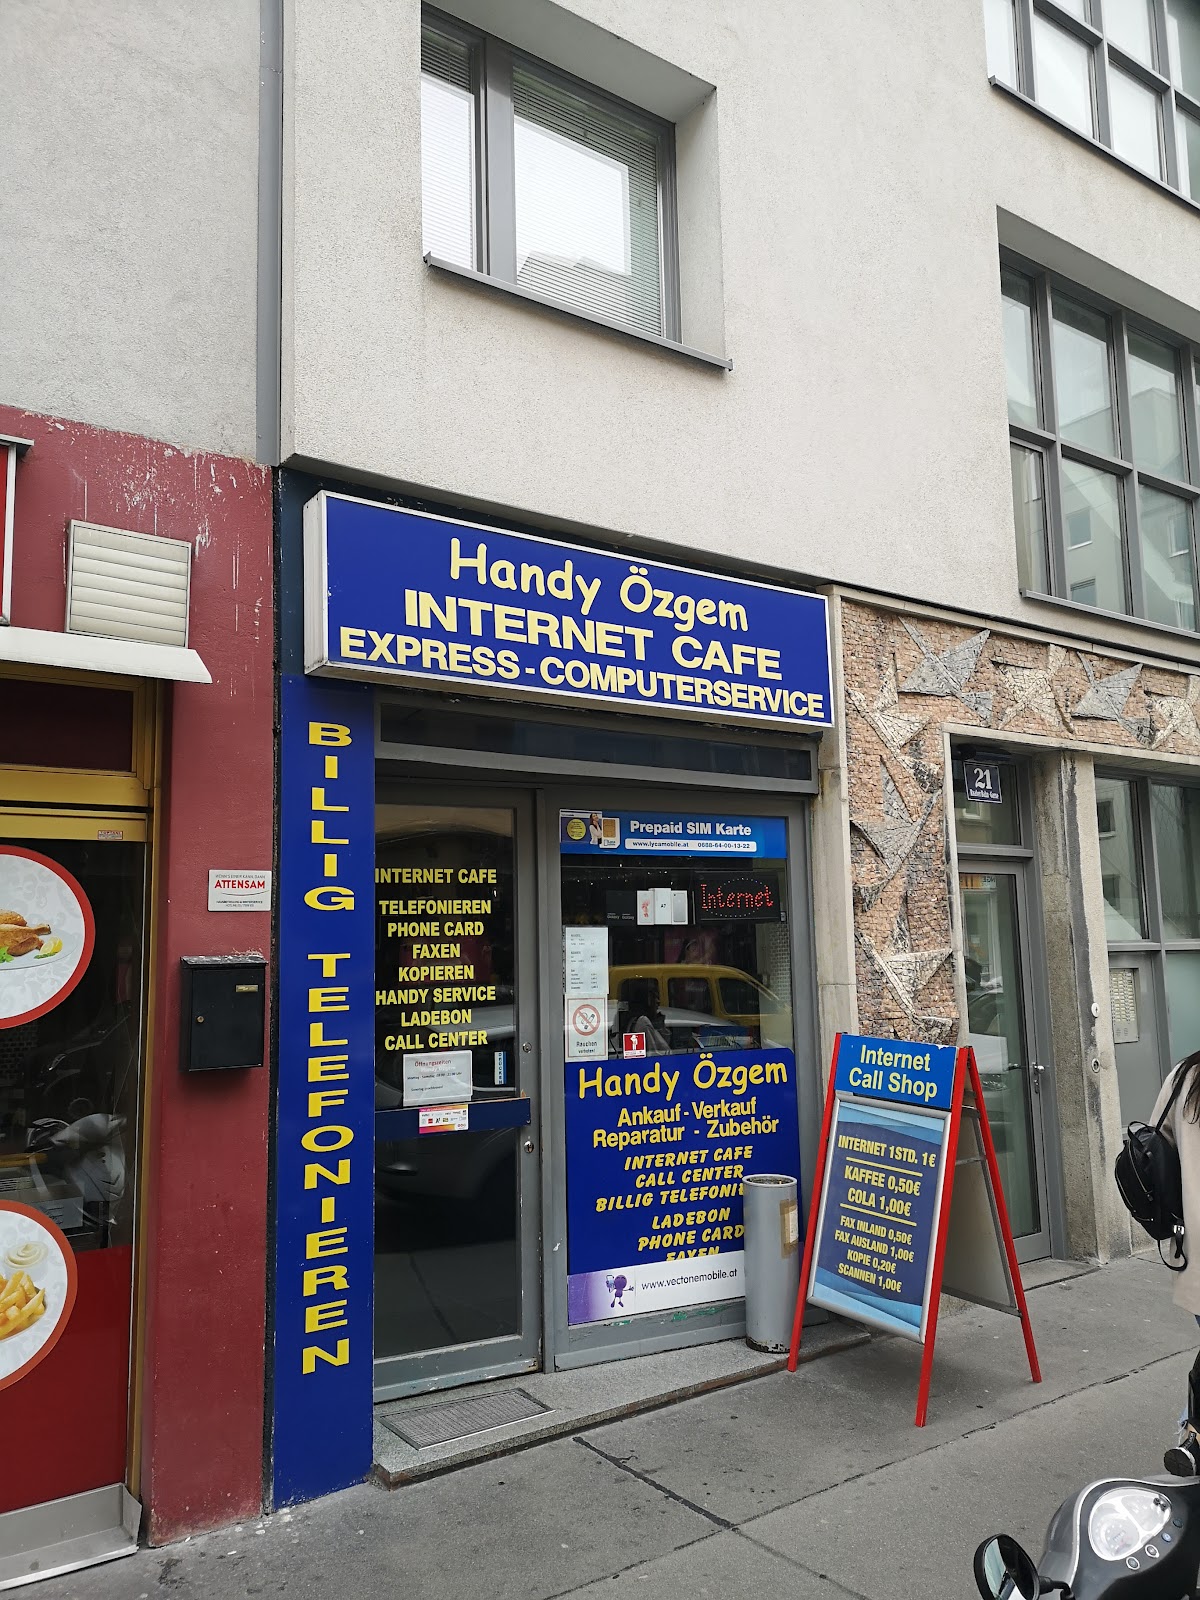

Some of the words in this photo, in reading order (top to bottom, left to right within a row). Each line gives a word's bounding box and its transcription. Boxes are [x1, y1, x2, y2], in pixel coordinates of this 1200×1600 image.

[450, 538, 601, 615] Handy
[620, 566, 749, 632] Özgem
[404, 590, 654, 662] INTERNET
[672, 637, 782, 680] CAFE
[340, 627, 519, 680] EXPRESS
[540, 657, 824, 718] COMPUTERSERVICE
[974, 768, 992, 789] 21
[303, 721, 355, 911] BILLIG
[630, 820, 682, 835] Prepaid
[686, 821, 712, 835] SIM
[716, 822, 751, 836] Karte
[214, 880, 266, 889] ATTENSAM
[374, 868, 454, 884] INTERNET
[457, 868, 497, 884] CAFE
[378, 899, 492, 915] TELEFONIEREN
[700, 884, 774, 909] Internet
[387, 921, 440, 938] PHONE
[443, 921, 485, 937] CARD
[412, 943, 461, 960] FAXEN
[398, 964, 475, 982] KOPIEREN
[375, 988, 429, 1006] HANDY
[432, 985, 496, 1003] SERVICE
[401, 1008, 472, 1027] LADEBON
[384, 1033, 425, 1051] CALL
[428, 1029, 488, 1049] CENTER
[860, 1044, 931, 1072] Internet
[578, 1062, 680, 1101] Handy
[693, 1053, 788, 1095] Özgem
[849, 1067, 884, 1090] Call
[888, 1072, 938, 1102] Shop
[617, 1103, 681, 1127] Ankauf
[691, 1096, 757, 1120] Verkauf
[593, 1126, 685, 1151] Reparatur
[706, 1115, 779, 1139] Zubehör
[301, 953, 354, 1375] TELEFONIEREN
[624, 1149, 709, 1171] INTERNET
[713, 1146, 753, 1162] CAFE
[838, 1135, 887, 1157] INTERNET
[889, 1145, 918, 1164] 1STD.
[922, 1152, 937, 1168] 1€
[635, 1171, 675, 1189] CALL
[681, 1164, 744, 1183] CENTER
[844, 1165, 886, 1188] KAFFEE
[888, 1175, 921, 1197] 0,50€
[595, 1192, 654, 1213] BILLIG
[847, 1187, 876, 1208] COLA
[879, 1195, 912, 1217] 1,00€
[651, 1207, 731, 1230] LADEBON
[840, 1215, 854, 1228] FAX
[857, 1221, 887, 1239] INLAND
[888, 1229, 912, 1245] 0,50€
[637, 1230, 697, 1251] PHONE
[701, 1224, 745, 1243] CARD
[834, 1230, 850, 1244] FAX
[851, 1235, 889, 1255] AUSLAND
[890, 1246, 914, 1262] 1,00€
[847, 1249, 871, 1267] KOPIE
[872, 1257, 897, 1274] 0,20€
[641, 1268, 738, 1290] www.vectonemobile.at
[838, 1263, 876, 1284] SCANNEN
[878, 1277, 902, 1293] 1,00€
